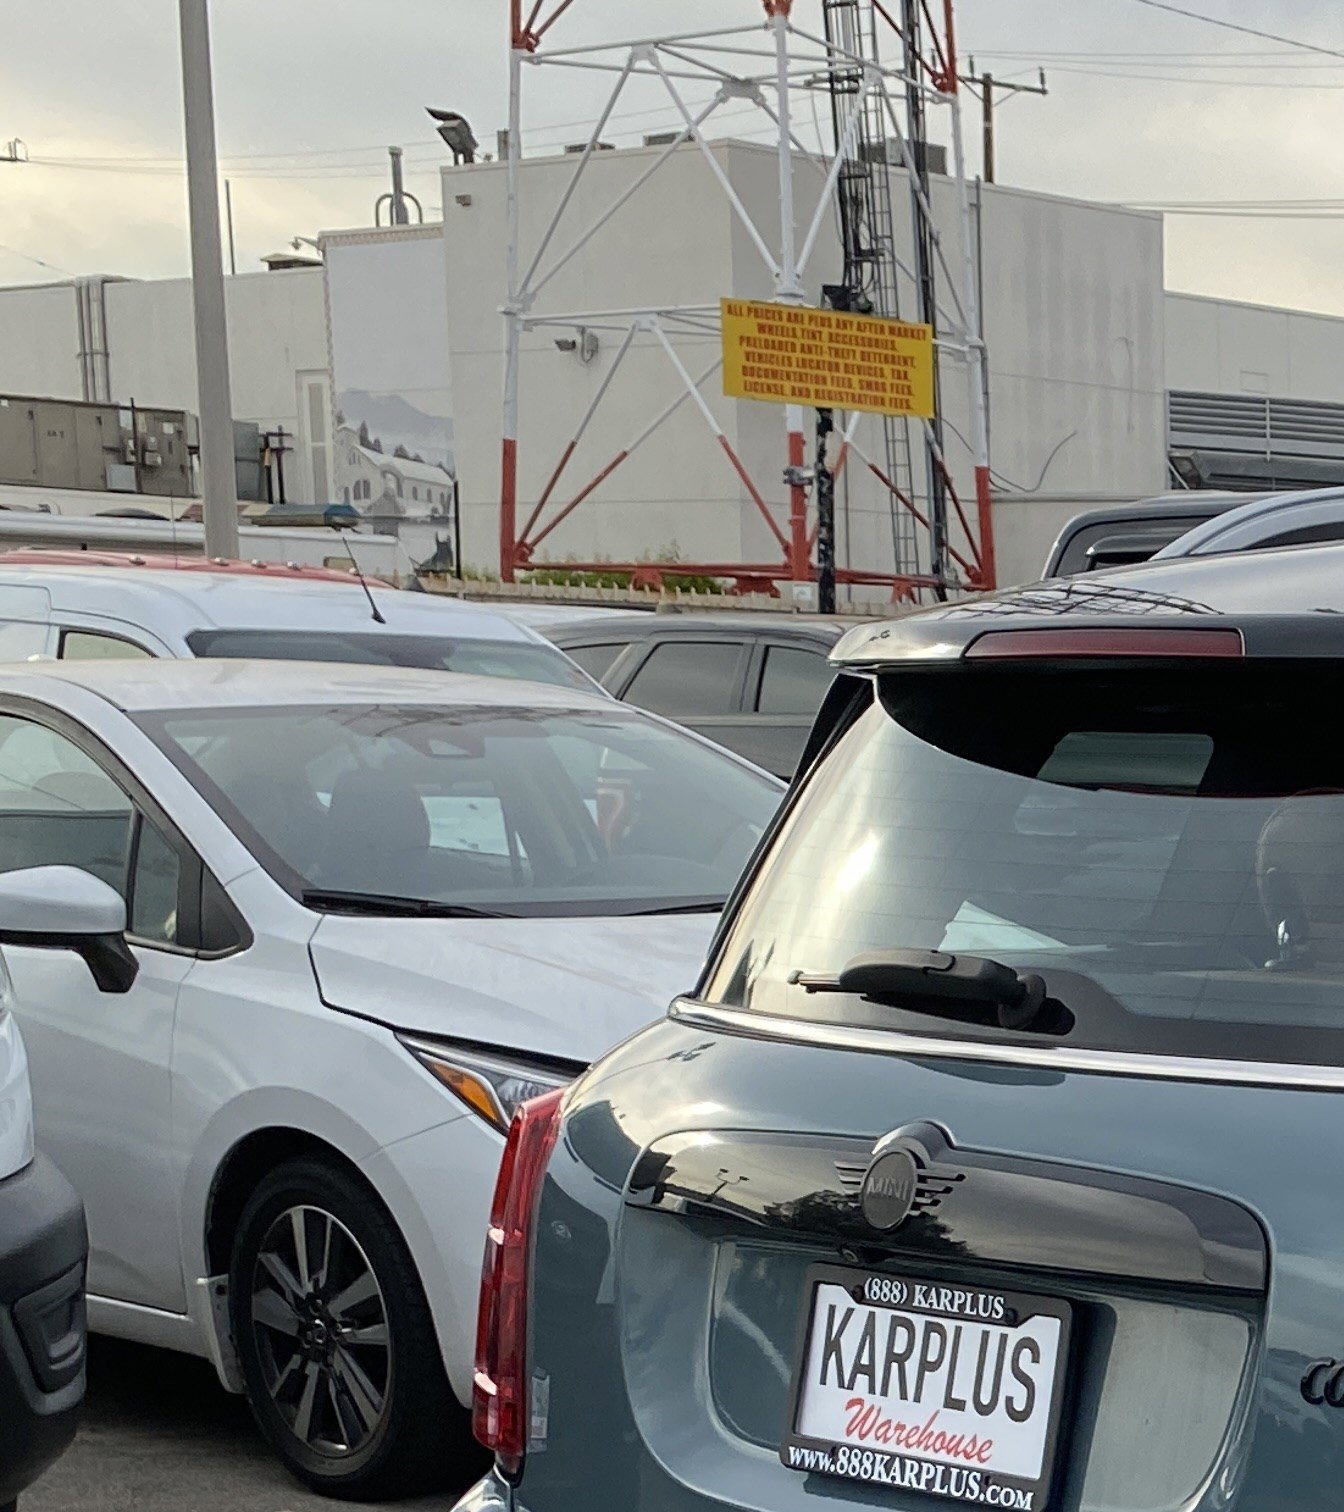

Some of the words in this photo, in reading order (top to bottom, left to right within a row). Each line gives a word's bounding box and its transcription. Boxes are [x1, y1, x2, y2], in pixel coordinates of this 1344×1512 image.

[726, 303, 743, 317] ALL
[746, 305, 783, 321] PRICES
[785, 311, 804, 324] ARE
[807, 313, 832, 328] PLUS
[834, 317, 854, 331] ANY
[855, 320, 886, 335] AFTER
[887, 325, 926, 341] MARKET
[738, 334, 797, 353] PRELOADED
[744, 350, 793, 367] VEHICLES
[795, 356, 840, 373] LOCATOR
[741, 364, 828, 385] DOCUMENTATION
[857, 378, 887, 393] SMOG
[789, 385, 811, 398] AND
[813, 387, 886, 407] REGISTRATION
[866, 1177, 910, 1204] MINI
[864, 1277, 908, 1304] (888)
[913, 1284, 1005, 1320] KARPLUS
[819, 1303, 1041, 1423] KARPLUS
[844, 1397, 993, 1464] Warehouse
